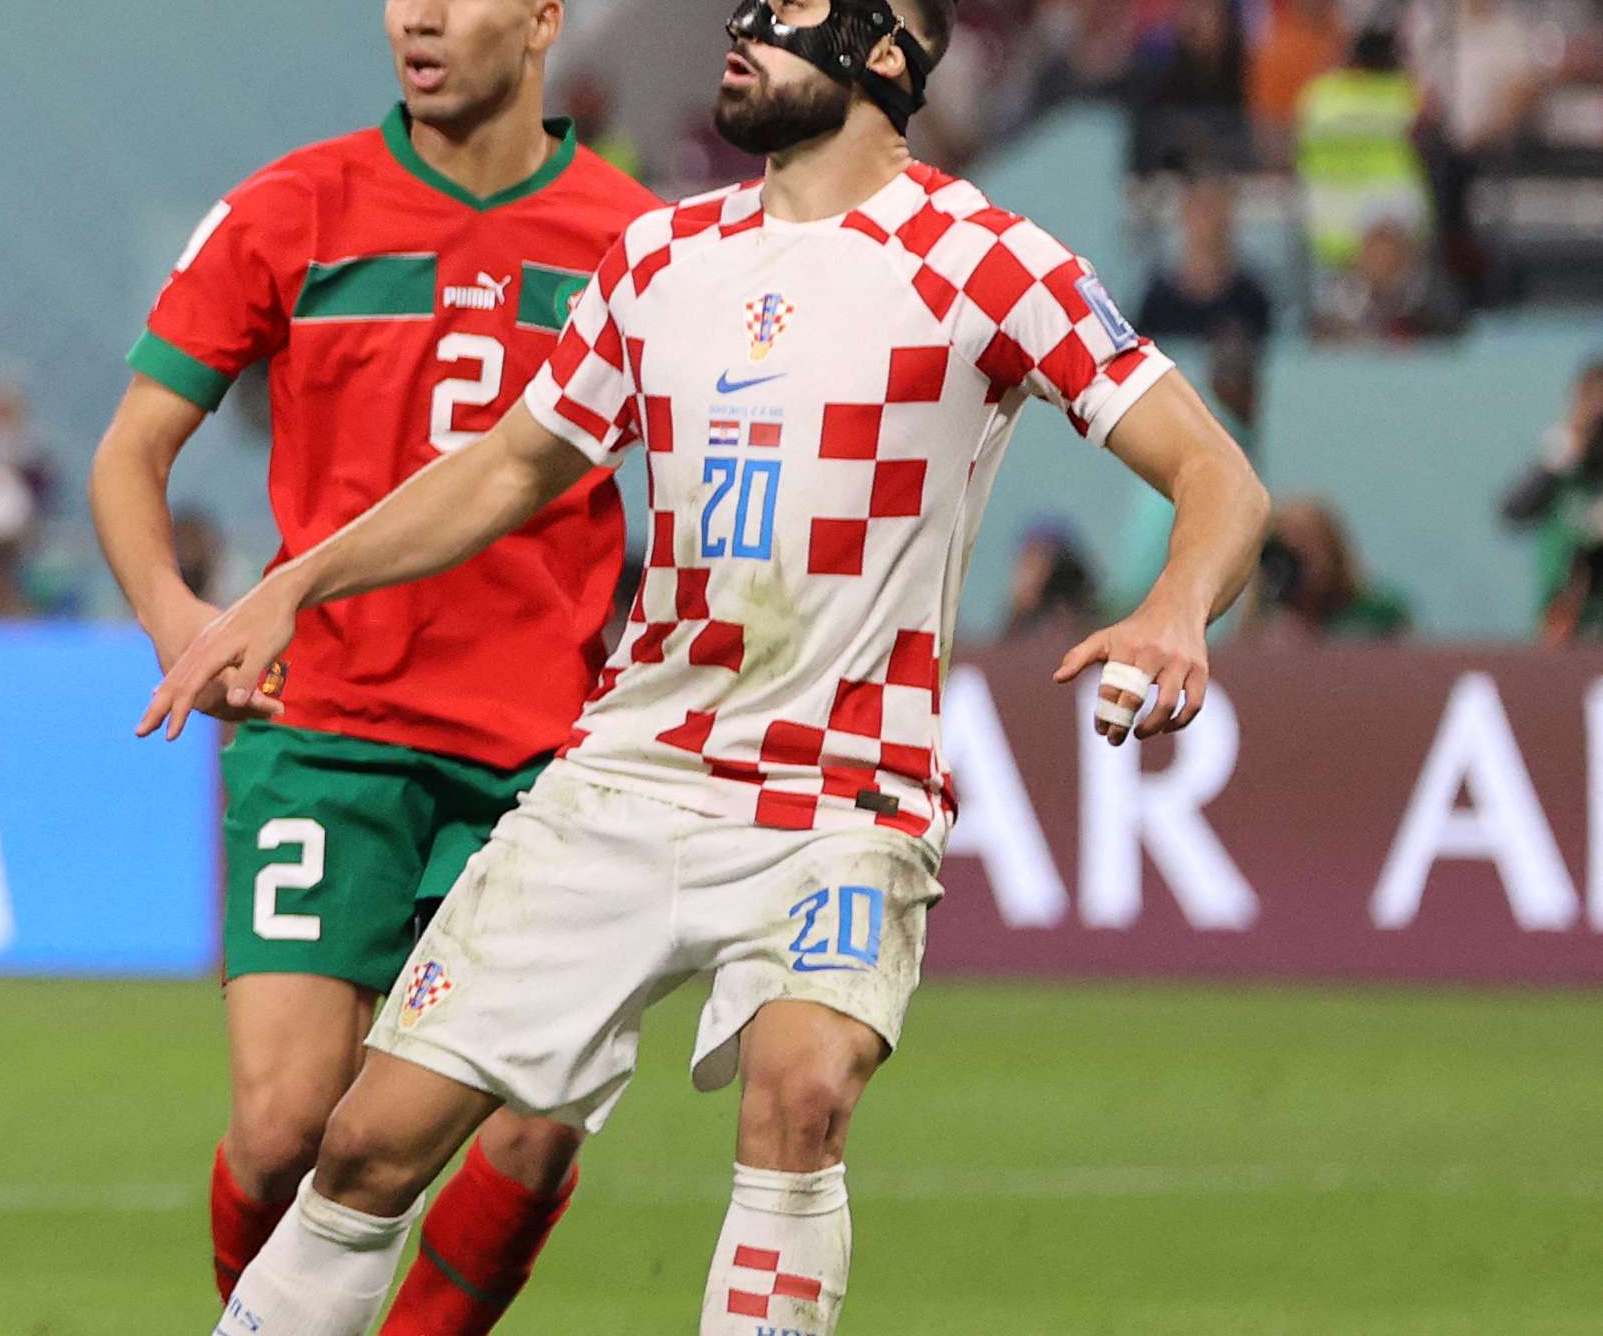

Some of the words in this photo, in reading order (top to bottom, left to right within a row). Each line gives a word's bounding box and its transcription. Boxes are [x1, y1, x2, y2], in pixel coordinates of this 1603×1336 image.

[429, 332, 505, 453] 2
[701, 456, 782, 560] 20
[1368, 669, 1603, 931] A
[252, 818, 325, 941] 2
[789, 886, 884, 968] 20
